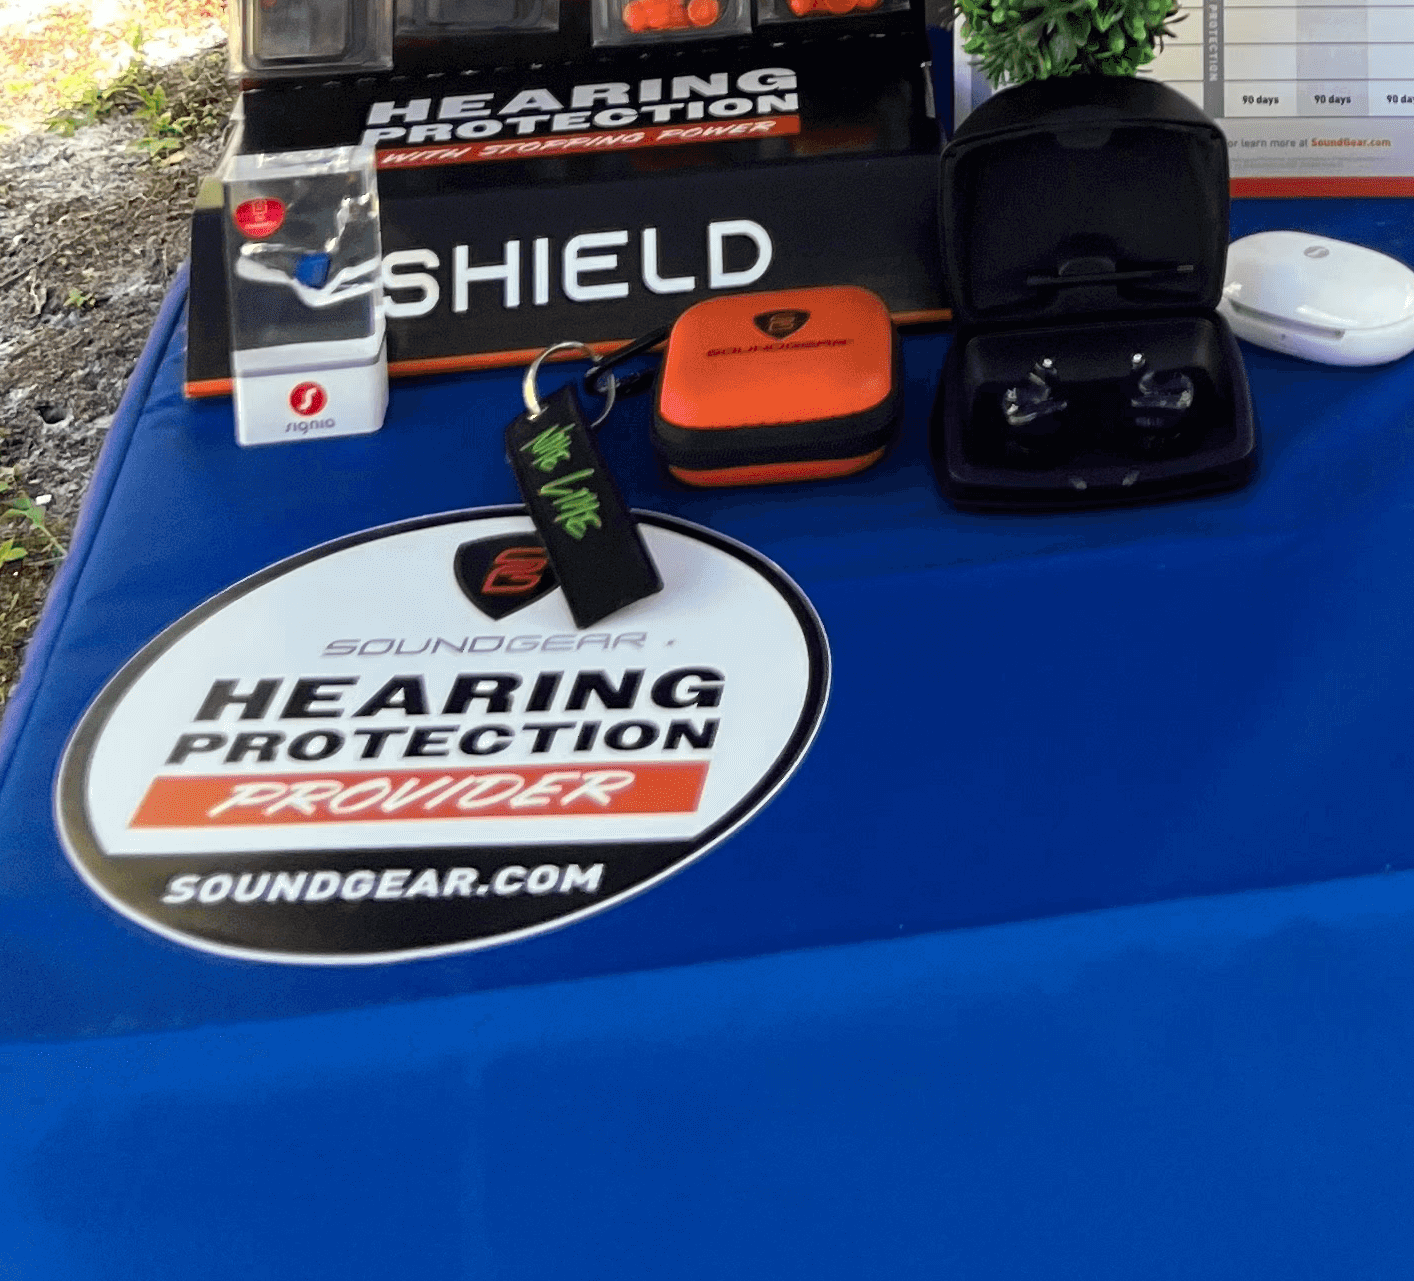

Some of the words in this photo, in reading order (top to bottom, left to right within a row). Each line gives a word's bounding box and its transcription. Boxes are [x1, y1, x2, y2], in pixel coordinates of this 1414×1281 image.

[1208, 5, 1218, 82] PROTECTION
[360, 92, 799, 146] PROTECTION
[367, 67, 798, 126] HEARING
[1242, 95, 1254, 104] 90
[1257, 95, 1279, 106] days
[1314, 95, 1326, 103] 90
[1328, 95, 1351, 106] days
[1386, 95, 1398, 103] 90
[382, 147, 447, 166] WITH
[482, 129, 646, 158] STOPPING
[666, 119, 776, 140] POWER
[1241, 139, 1267, 147] learn
[1299, 139, 1308, 147] at
[379, 220, 773, 318] SHIELD
[322, 632, 646, 658] SOUNDGEAR
[190, 666, 726, 724] HEARING
[165, 717, 722, 765] PROTECTION
[206, 770, 637, 818] PROVIDER
[161, 864, 606, 906] SOUNDGEAR.COM
